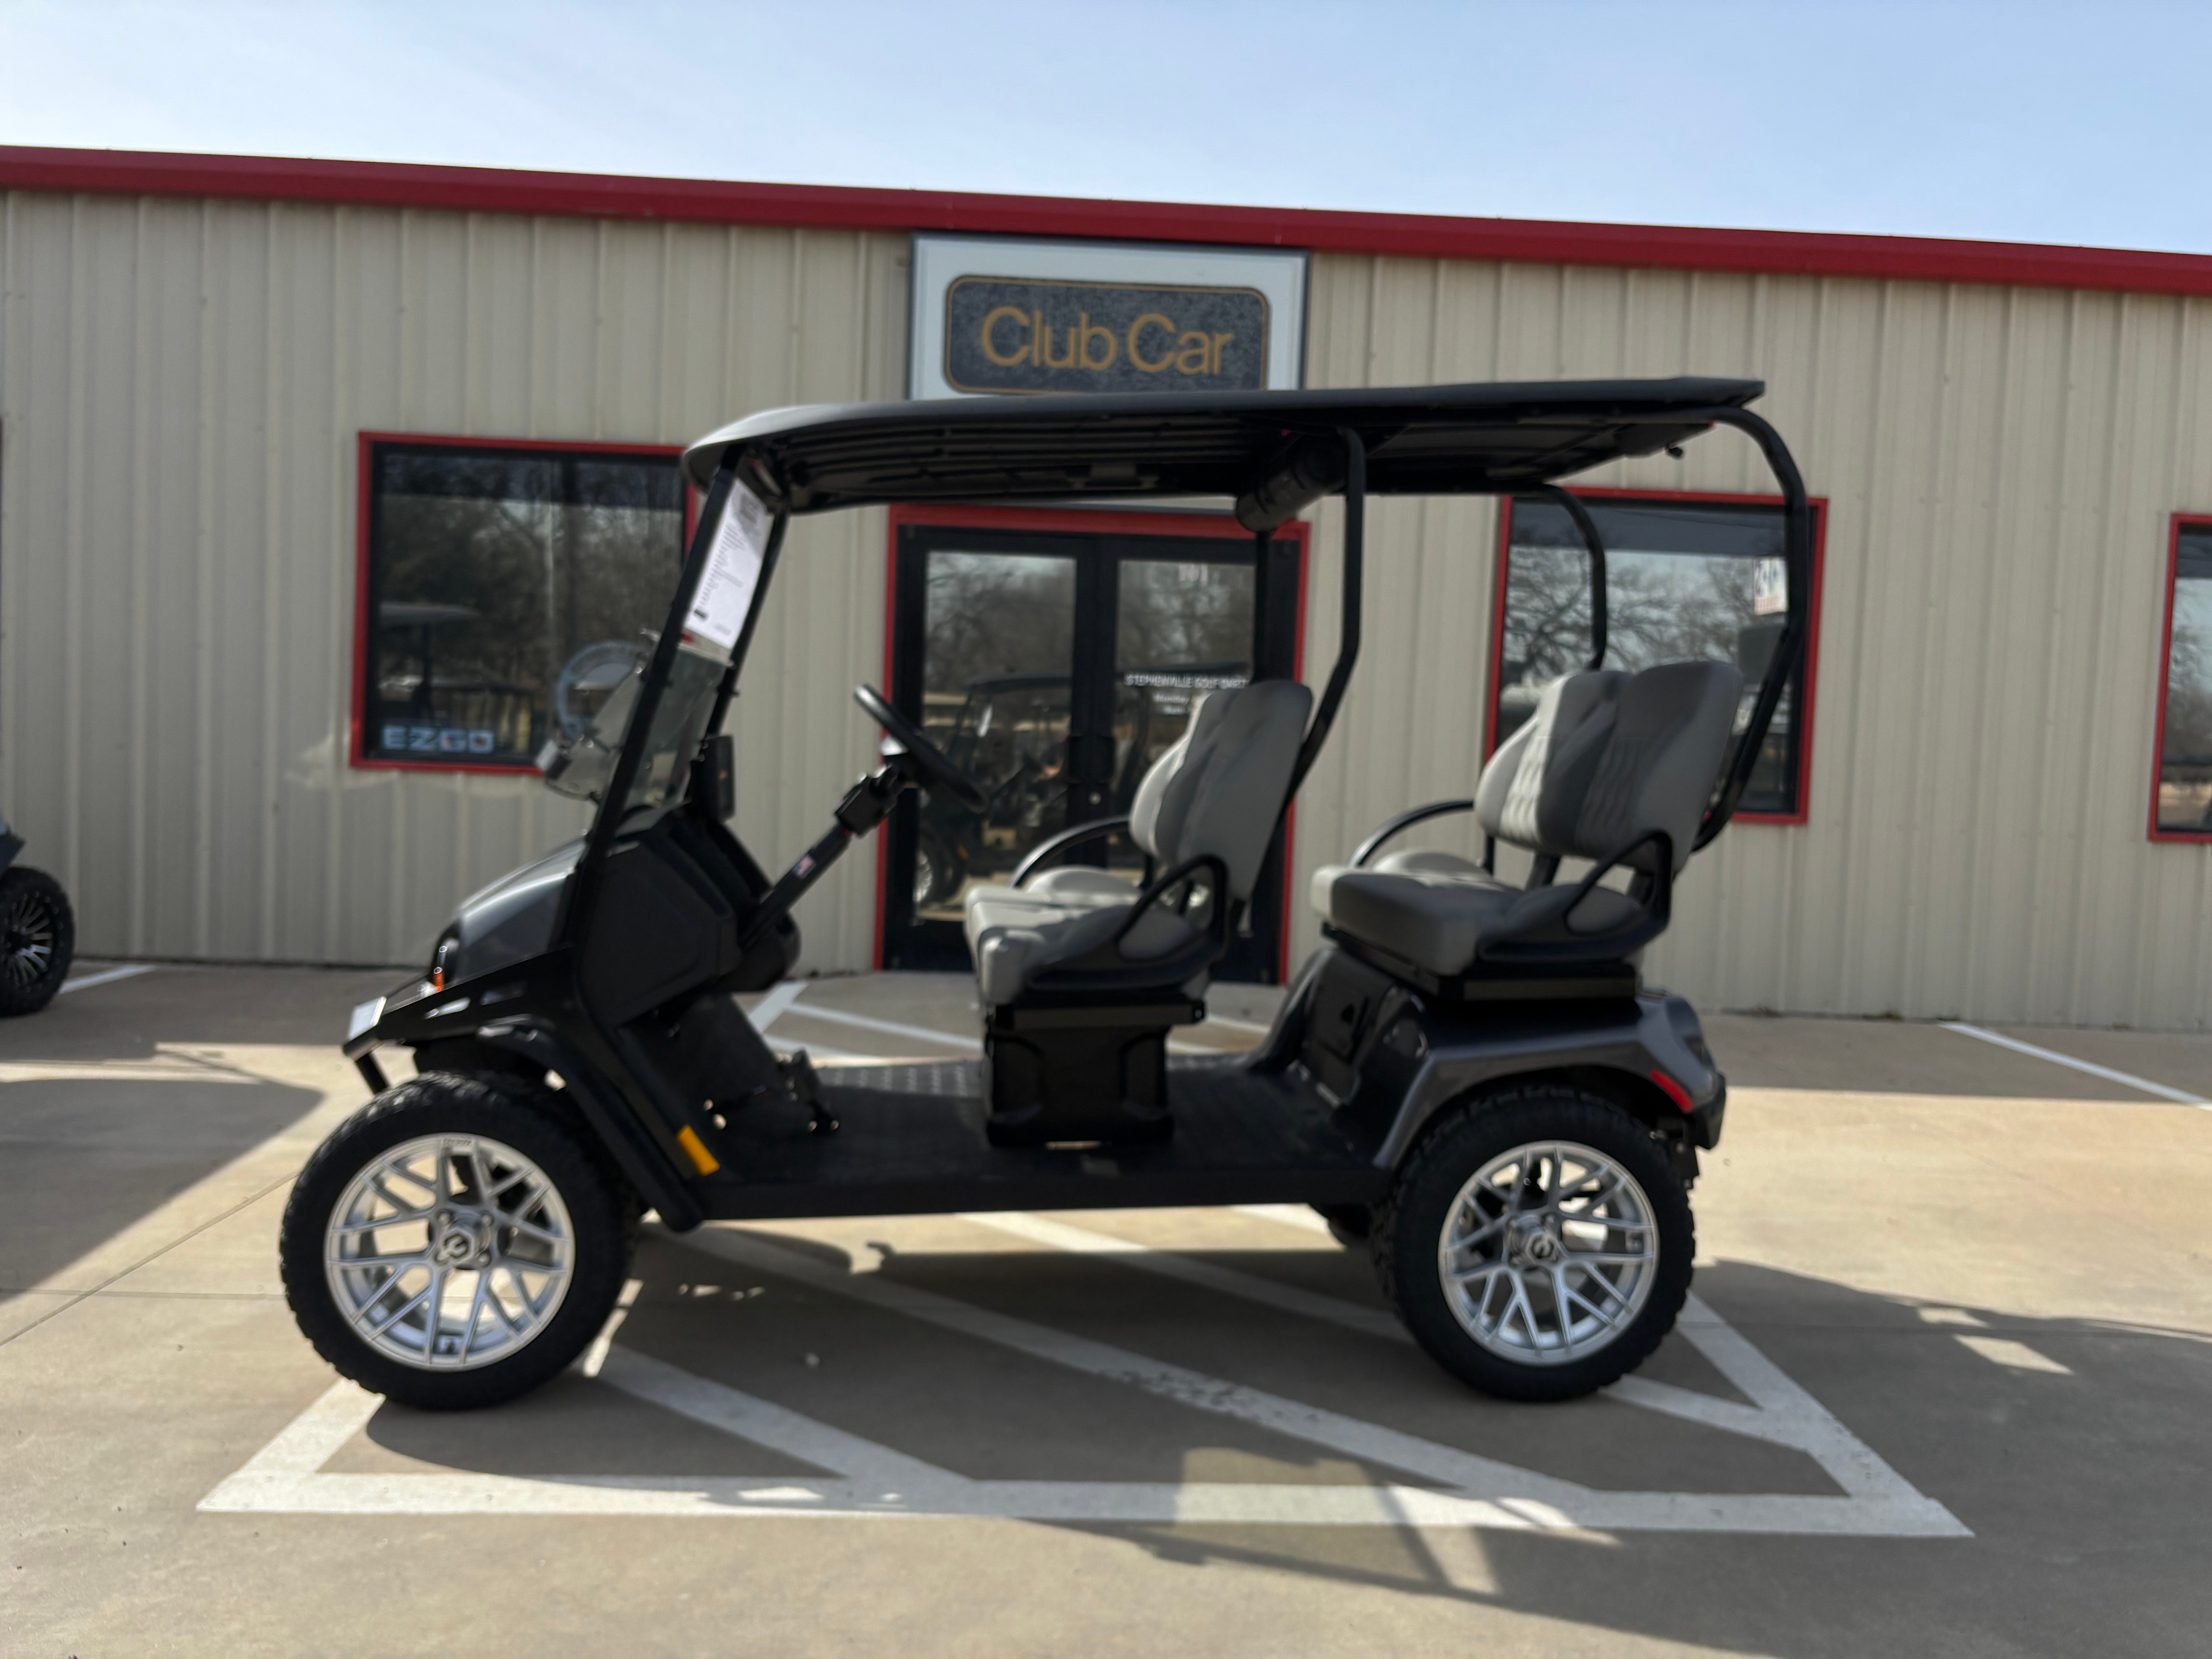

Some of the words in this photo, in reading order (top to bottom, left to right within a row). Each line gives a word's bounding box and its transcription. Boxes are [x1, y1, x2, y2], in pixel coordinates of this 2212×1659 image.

[981, 306, 1118, 371] Club
[1127, 313, 1234, 375] Car
[1124, 674, 1192, 688] STEPHENVILLE
[1194, 676, 1217, 689] GOLF
[383, 725, 494, 753] EZGO
